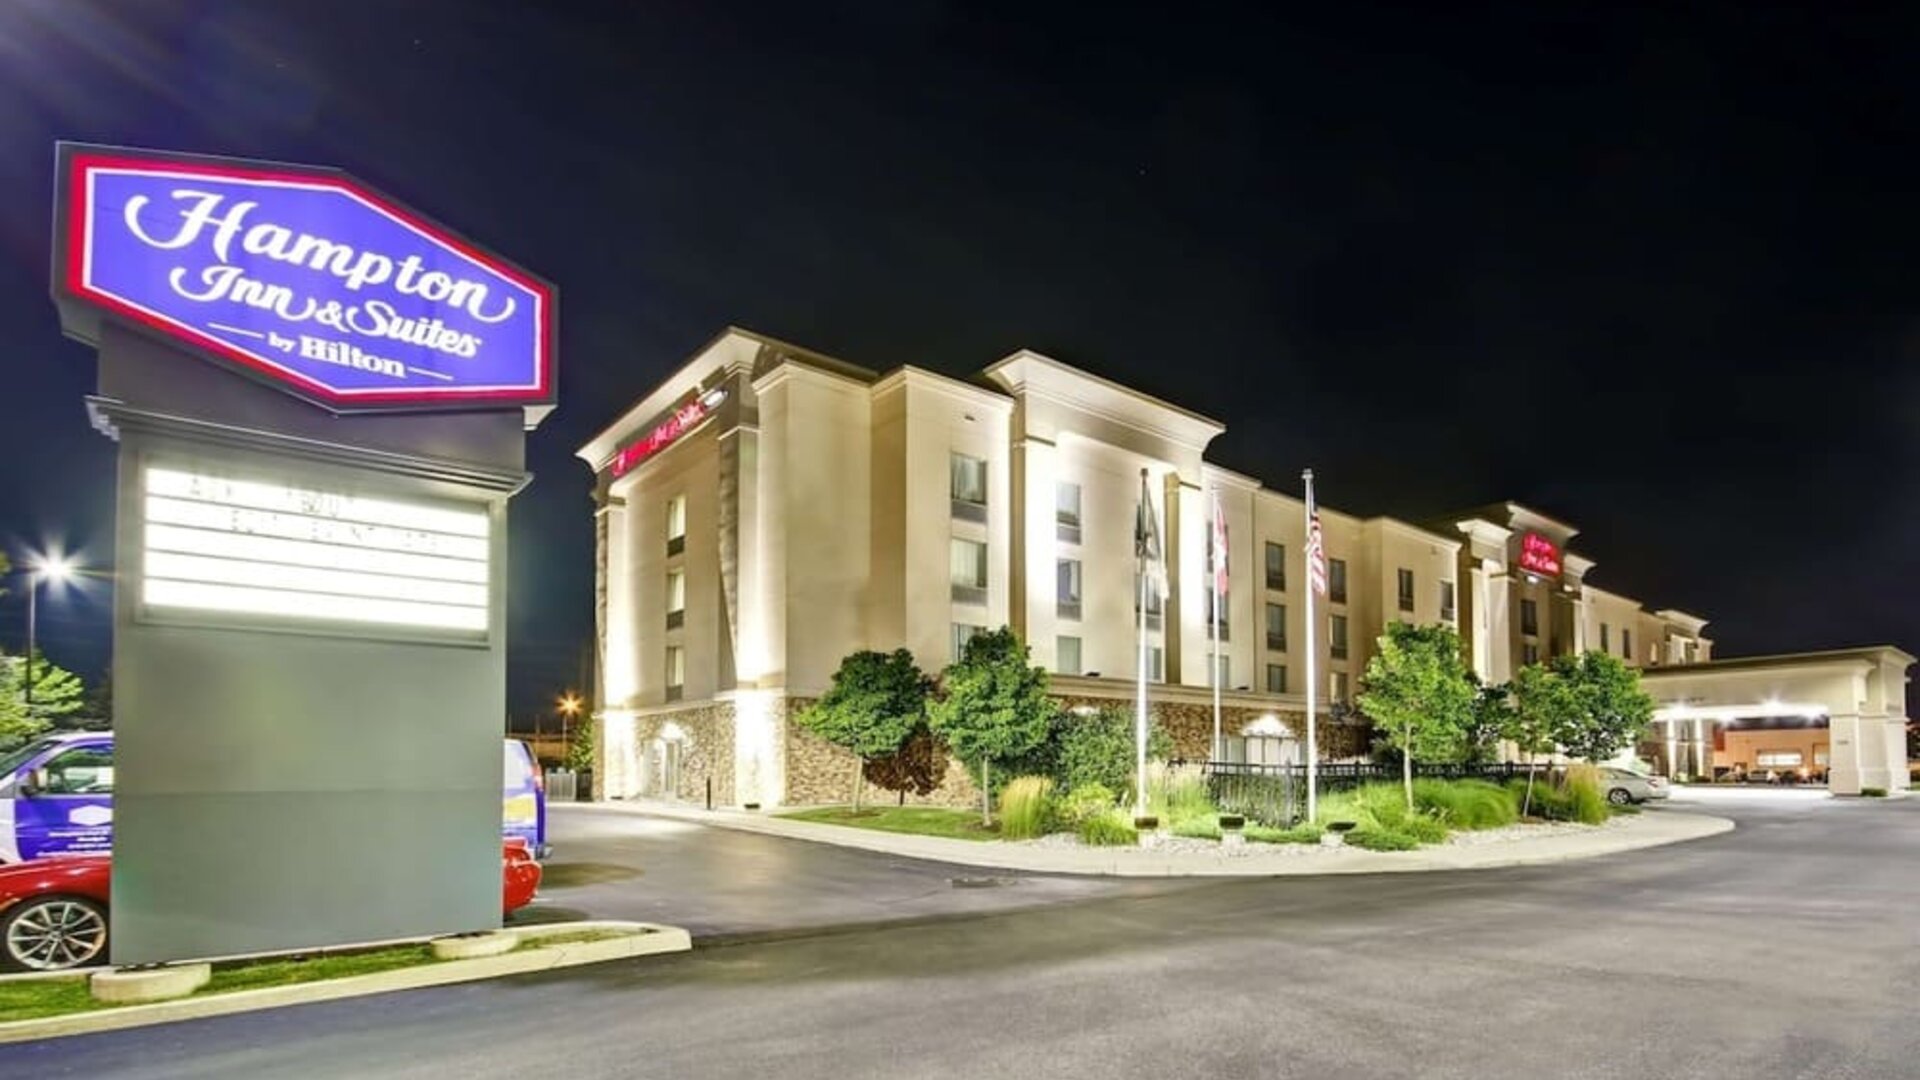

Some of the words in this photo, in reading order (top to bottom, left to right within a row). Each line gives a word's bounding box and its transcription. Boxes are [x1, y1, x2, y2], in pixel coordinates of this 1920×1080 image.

[125, 190, 515, 322] Hampton
[169, 265, 316, 320] Inn
[316, 302, 348, 332] &
[347, 301, 482, 357] Suites
[268, 332, 295, 352] by
[299, 336, 406, 377] Hilton
